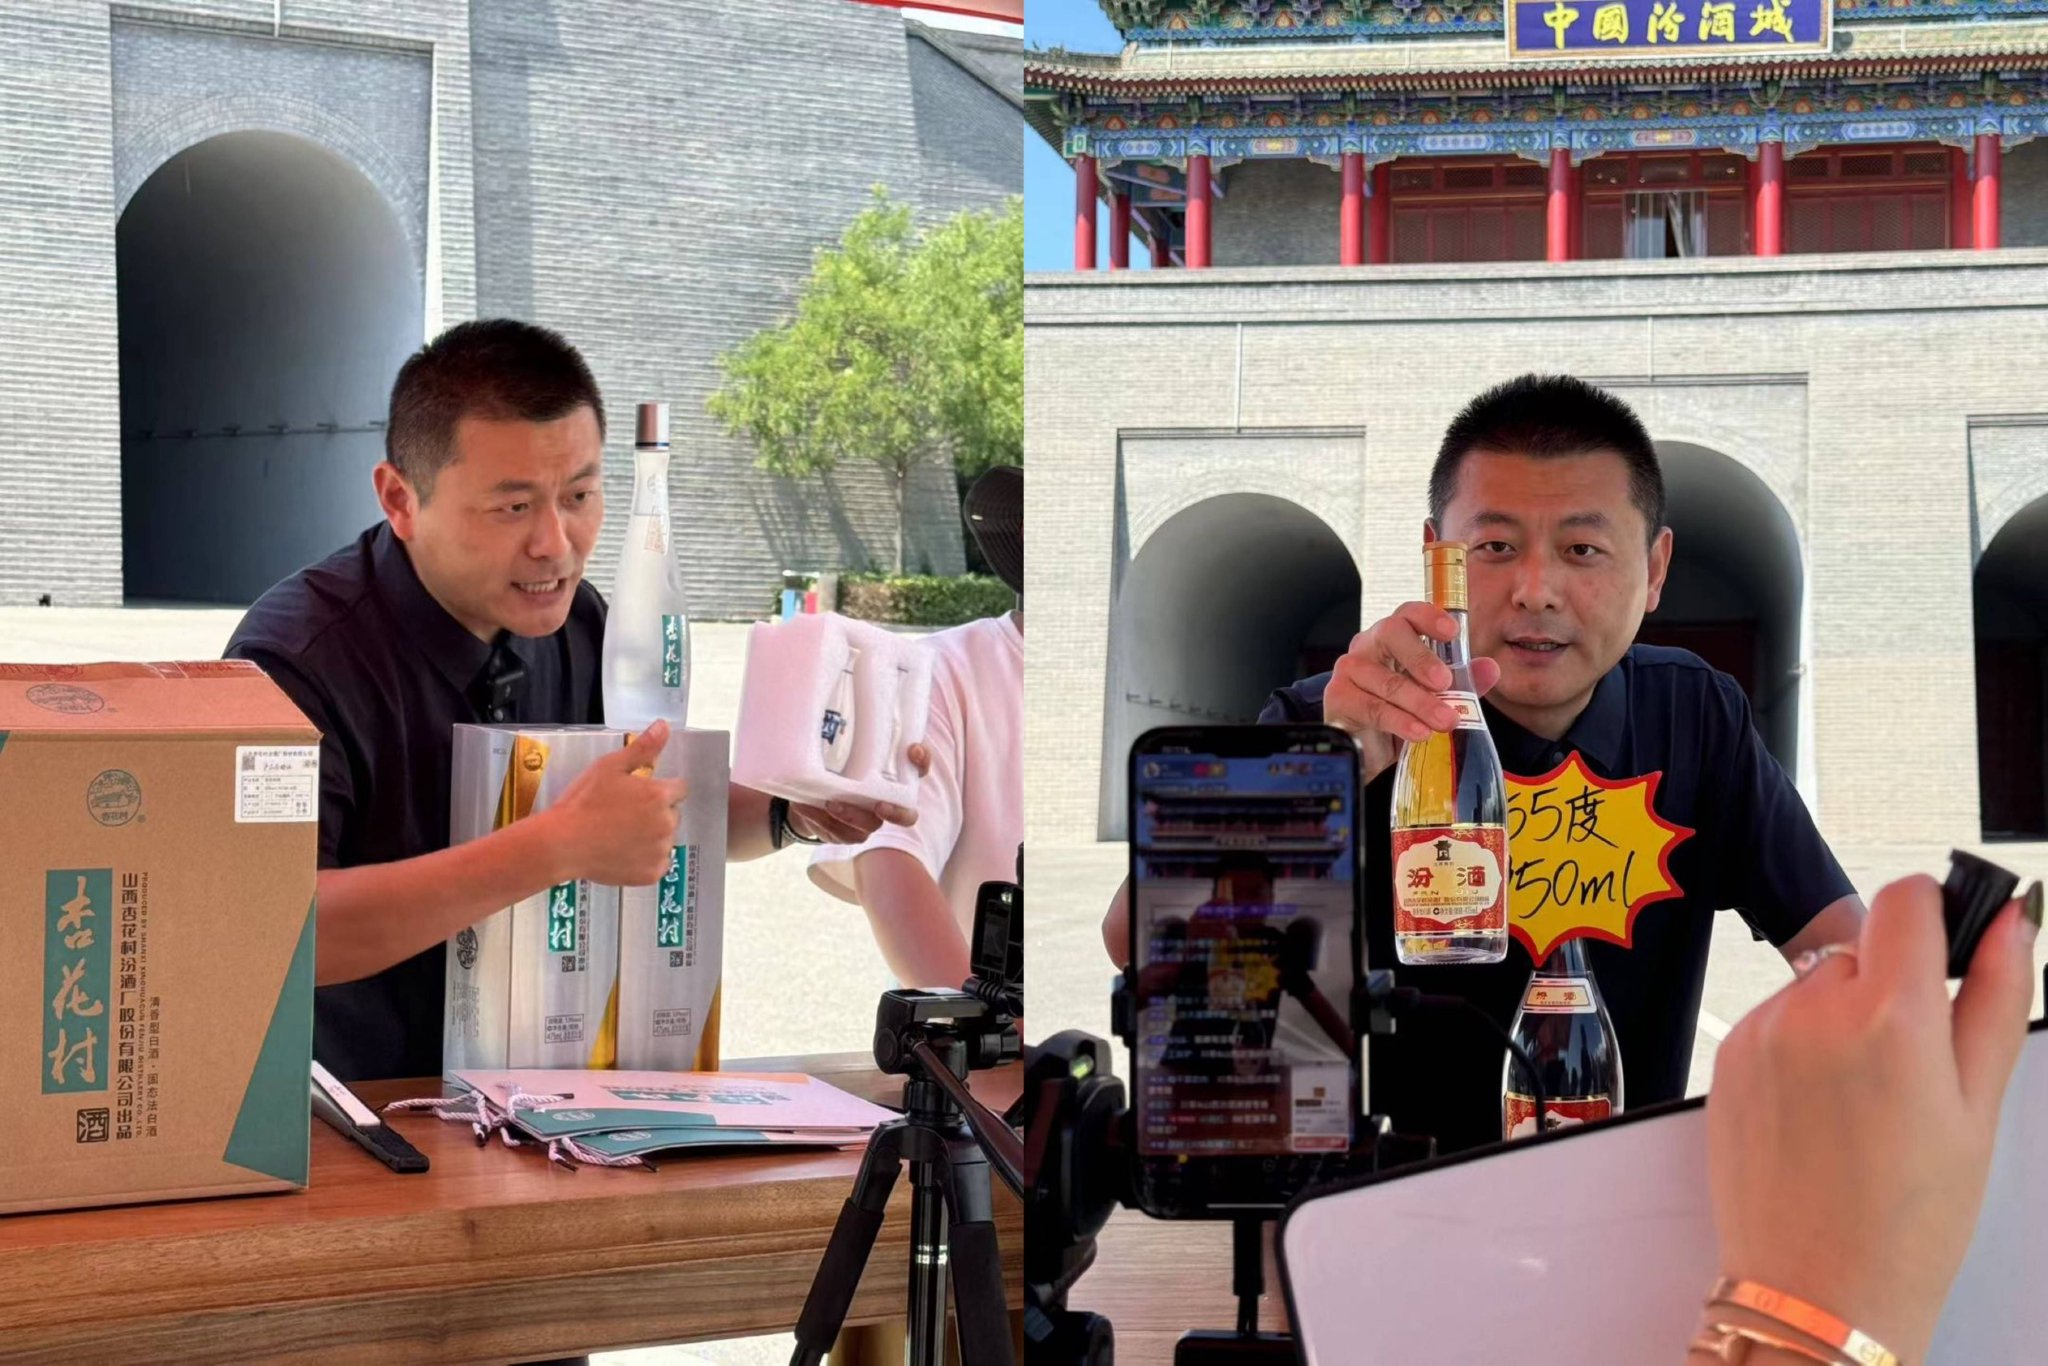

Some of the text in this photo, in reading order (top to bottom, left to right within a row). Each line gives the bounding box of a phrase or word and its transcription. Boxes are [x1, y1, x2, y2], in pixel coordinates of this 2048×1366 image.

[1543, 0, 1795, 49] 中國汾酒城
[664, 615, 680, 684] 杏花村
[1407, 865, 1487, 889] 汾酒
[1508, 850, 1635, 919] 50ml
[550, 880, 574, 949] 花村
[47, 875, 104, 1086] 杏花村
[116, 872, 138, 1140] 山西杏花村汾酒厂股份有限公司出品
[78, 1109, 109, 1142] 酒
